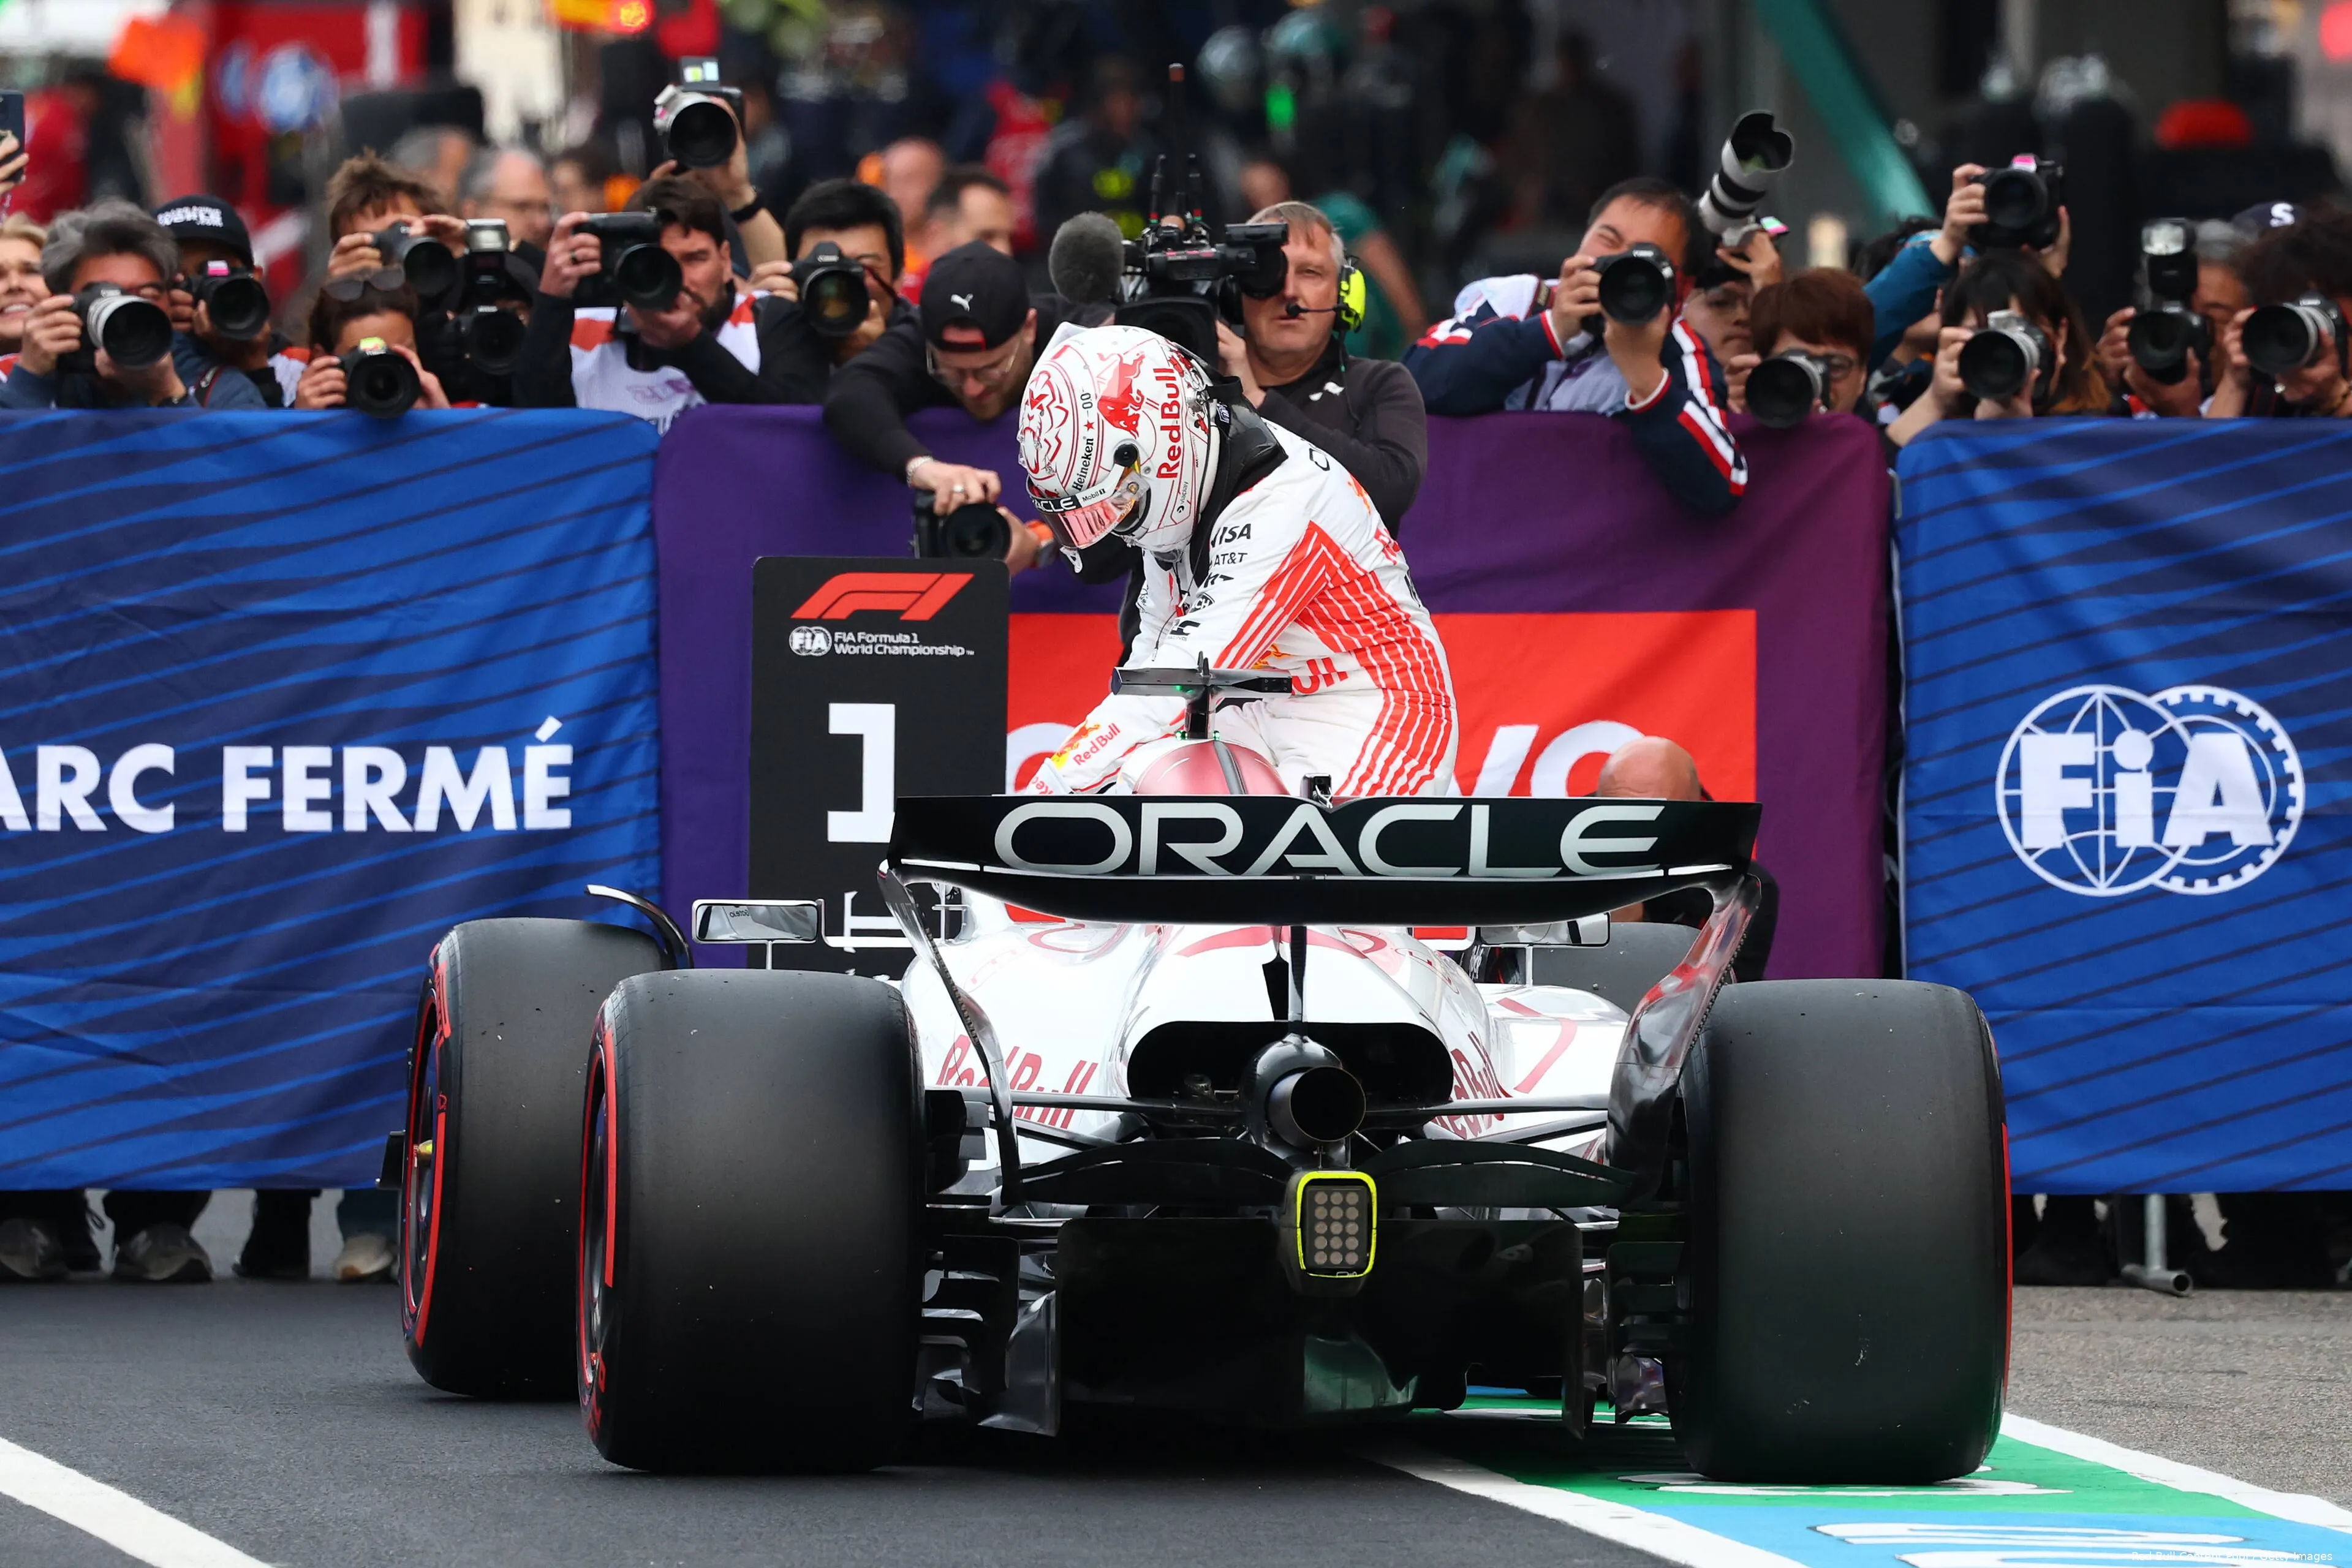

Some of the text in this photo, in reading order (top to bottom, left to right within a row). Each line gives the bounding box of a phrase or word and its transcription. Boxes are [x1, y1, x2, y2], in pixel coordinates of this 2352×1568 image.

[1153, 368, 1182, 479] Red Bull
[1072, 437, 1094, 491] Heineken
[1082, 491, 1099, 502] Mobil
[1211, 523, 1251, 548] VISA
[1214, 552, 1248, 565] AT&T
[834, 631, 920, 644] FIA Formula 1
[834, 644, 873, 655] World
[874, 644, 965, 657] Championship
[1291, 657, 1349, 696] ull
[1073, 723, 1121, 766] Red Bull
[223, 715, 573, 832] FERMÉ
[828, 703, 895, 843] 1
[994, 802, 1665, 876] ORACLE
